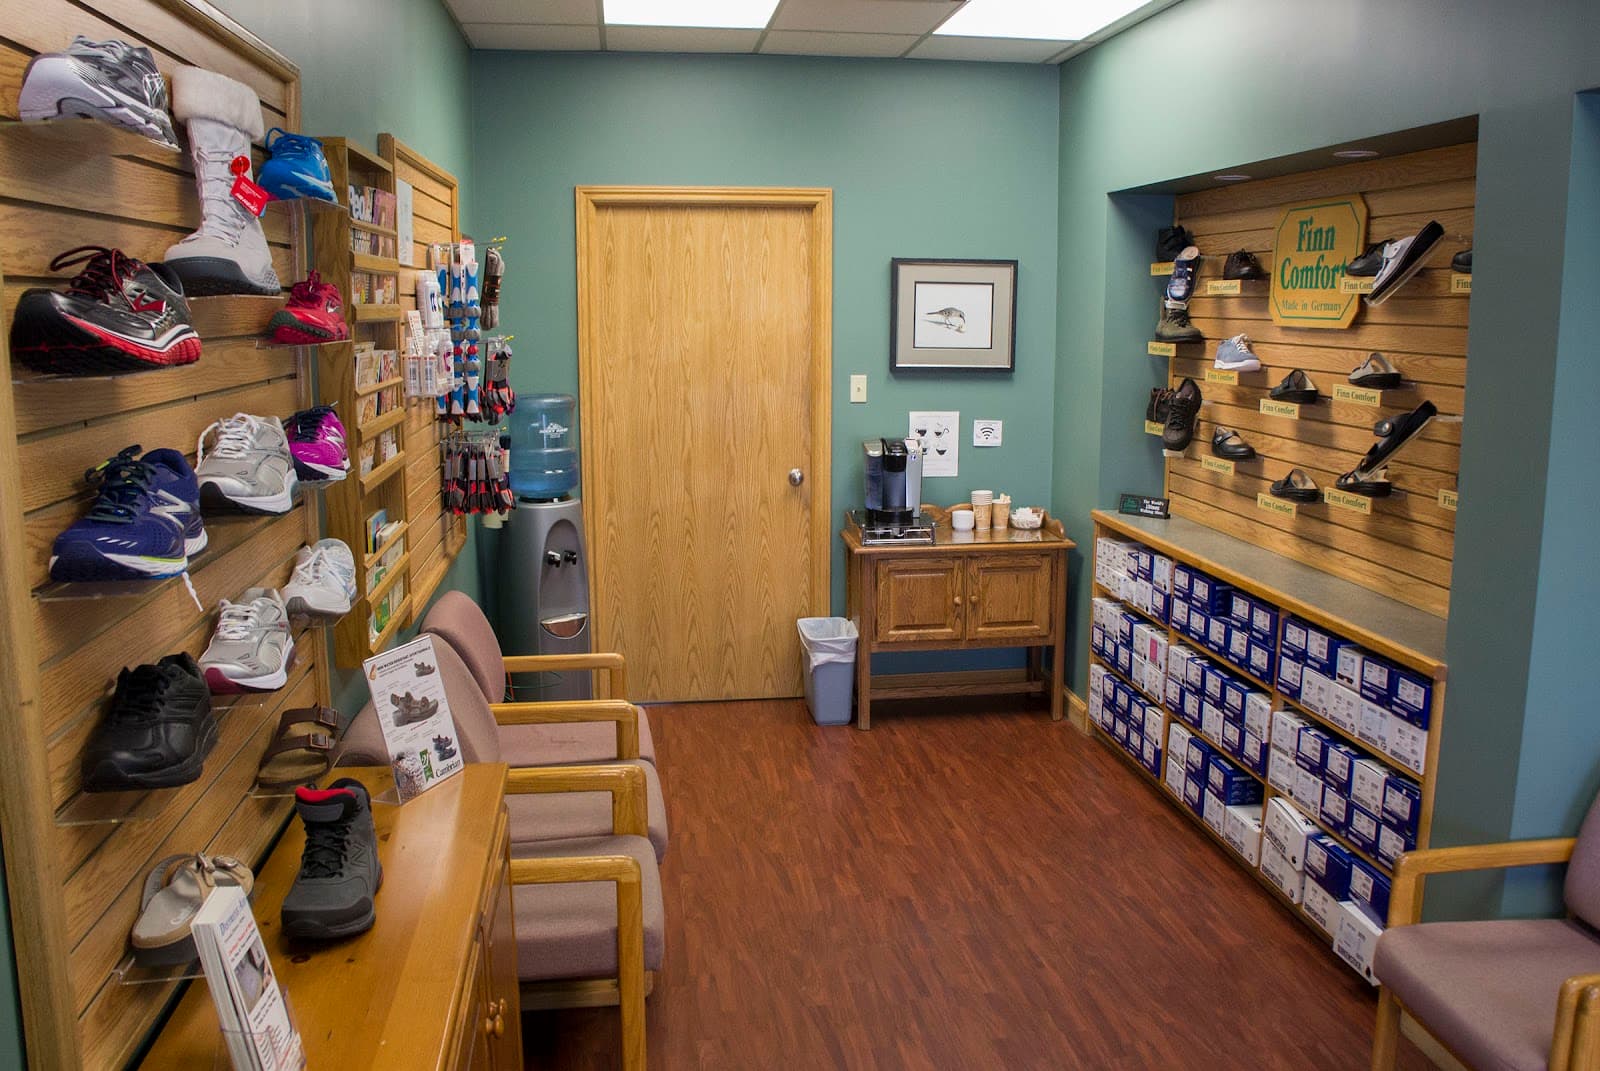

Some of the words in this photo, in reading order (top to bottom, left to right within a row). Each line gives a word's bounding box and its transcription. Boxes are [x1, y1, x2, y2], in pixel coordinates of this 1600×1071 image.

[1296, 215, 1336, 252] Finn
[1280, 254, 1347, 290] Comfort
[1343, 281, 1358, 290] Finn
[1282, 300, 1298, 310] Made
[1302, 300, 1308, 310] in
[1311, 300, 1341, 313] Germany
[1336, 388, 1350, 398] Finn
[1351, 391, 1377, 404] Comfort
[1327, 492, 1341, 503] Finn
[1342, 496, 1367, 510] Comfort
